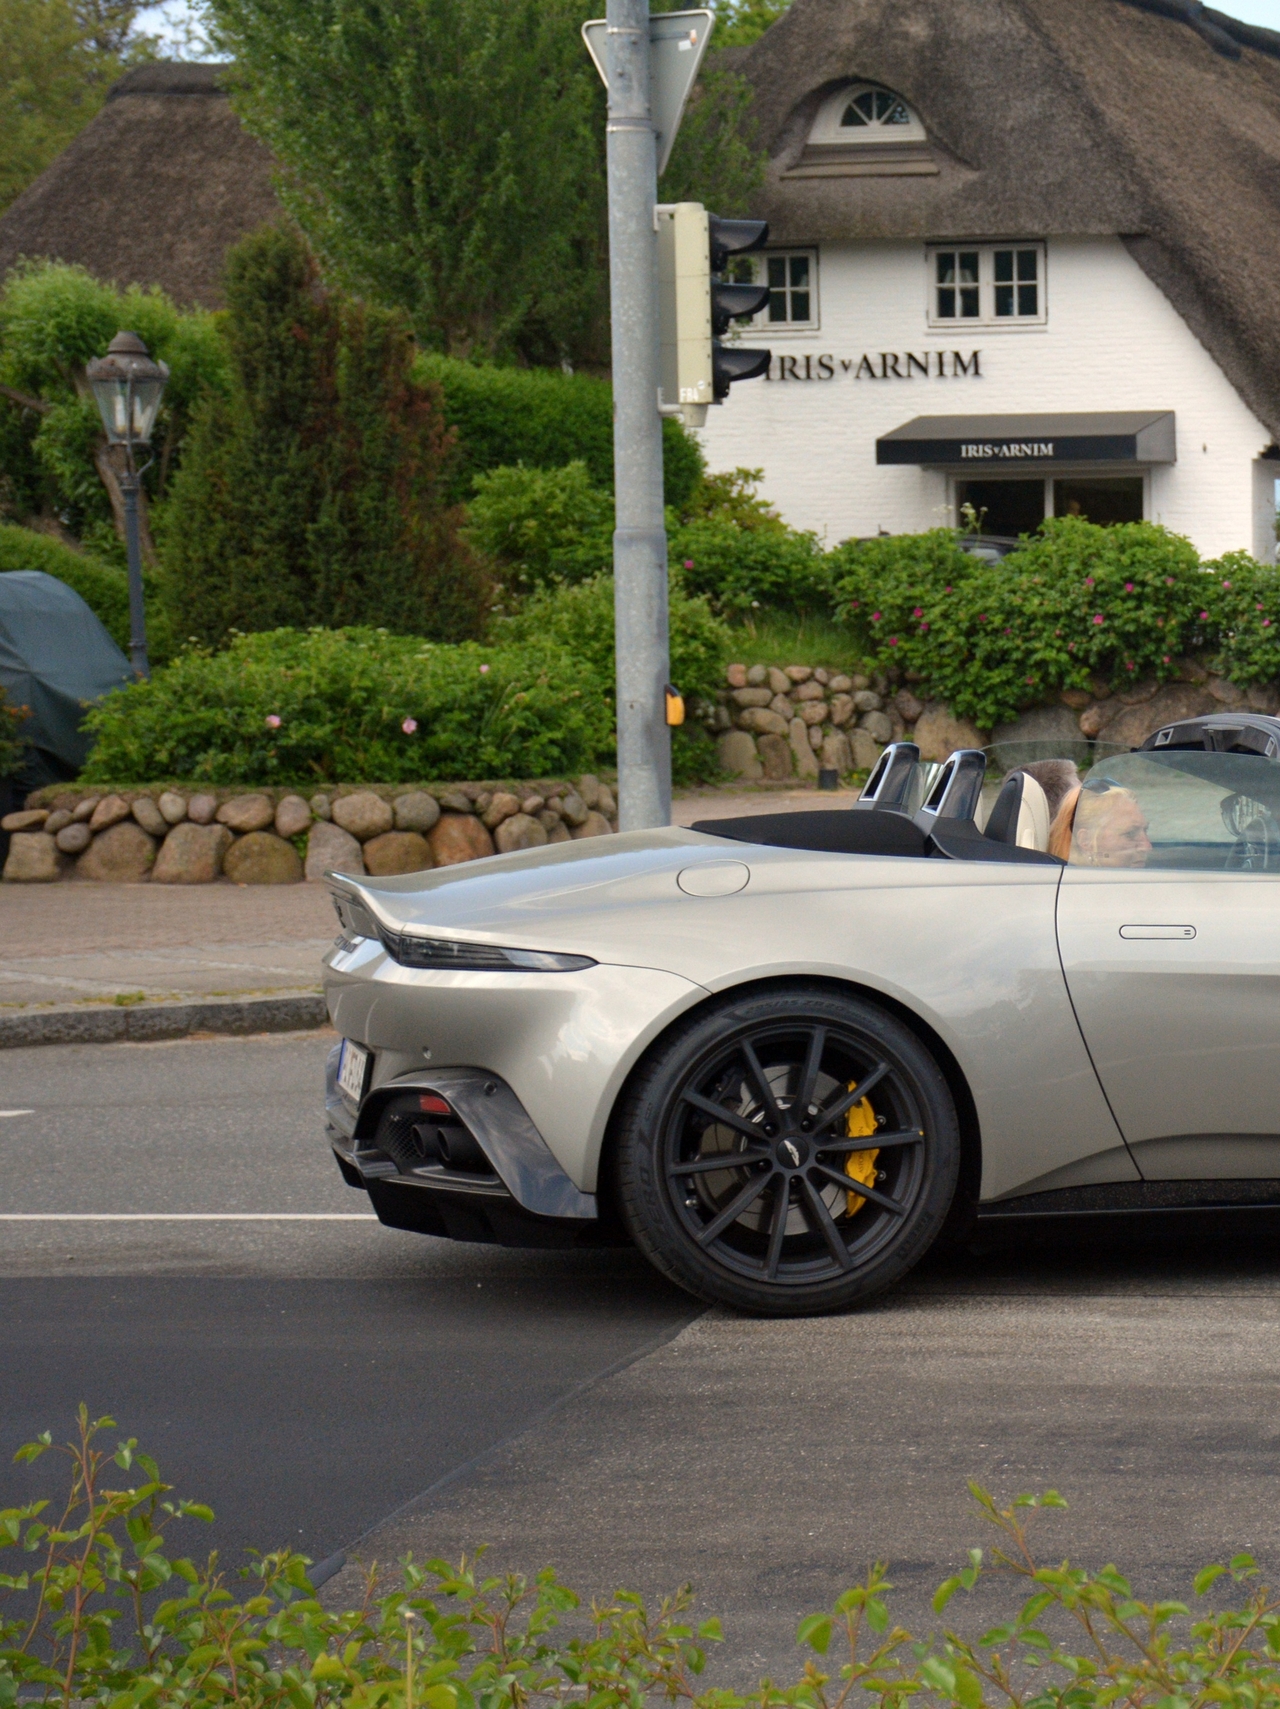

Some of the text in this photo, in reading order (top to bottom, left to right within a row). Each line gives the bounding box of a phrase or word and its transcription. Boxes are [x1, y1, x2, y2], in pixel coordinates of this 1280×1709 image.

[854, 349, 983, 380] ARNIM
[960, 444, 993, 458] IRIS
[999, 442, 1055, 458] ARNIM
